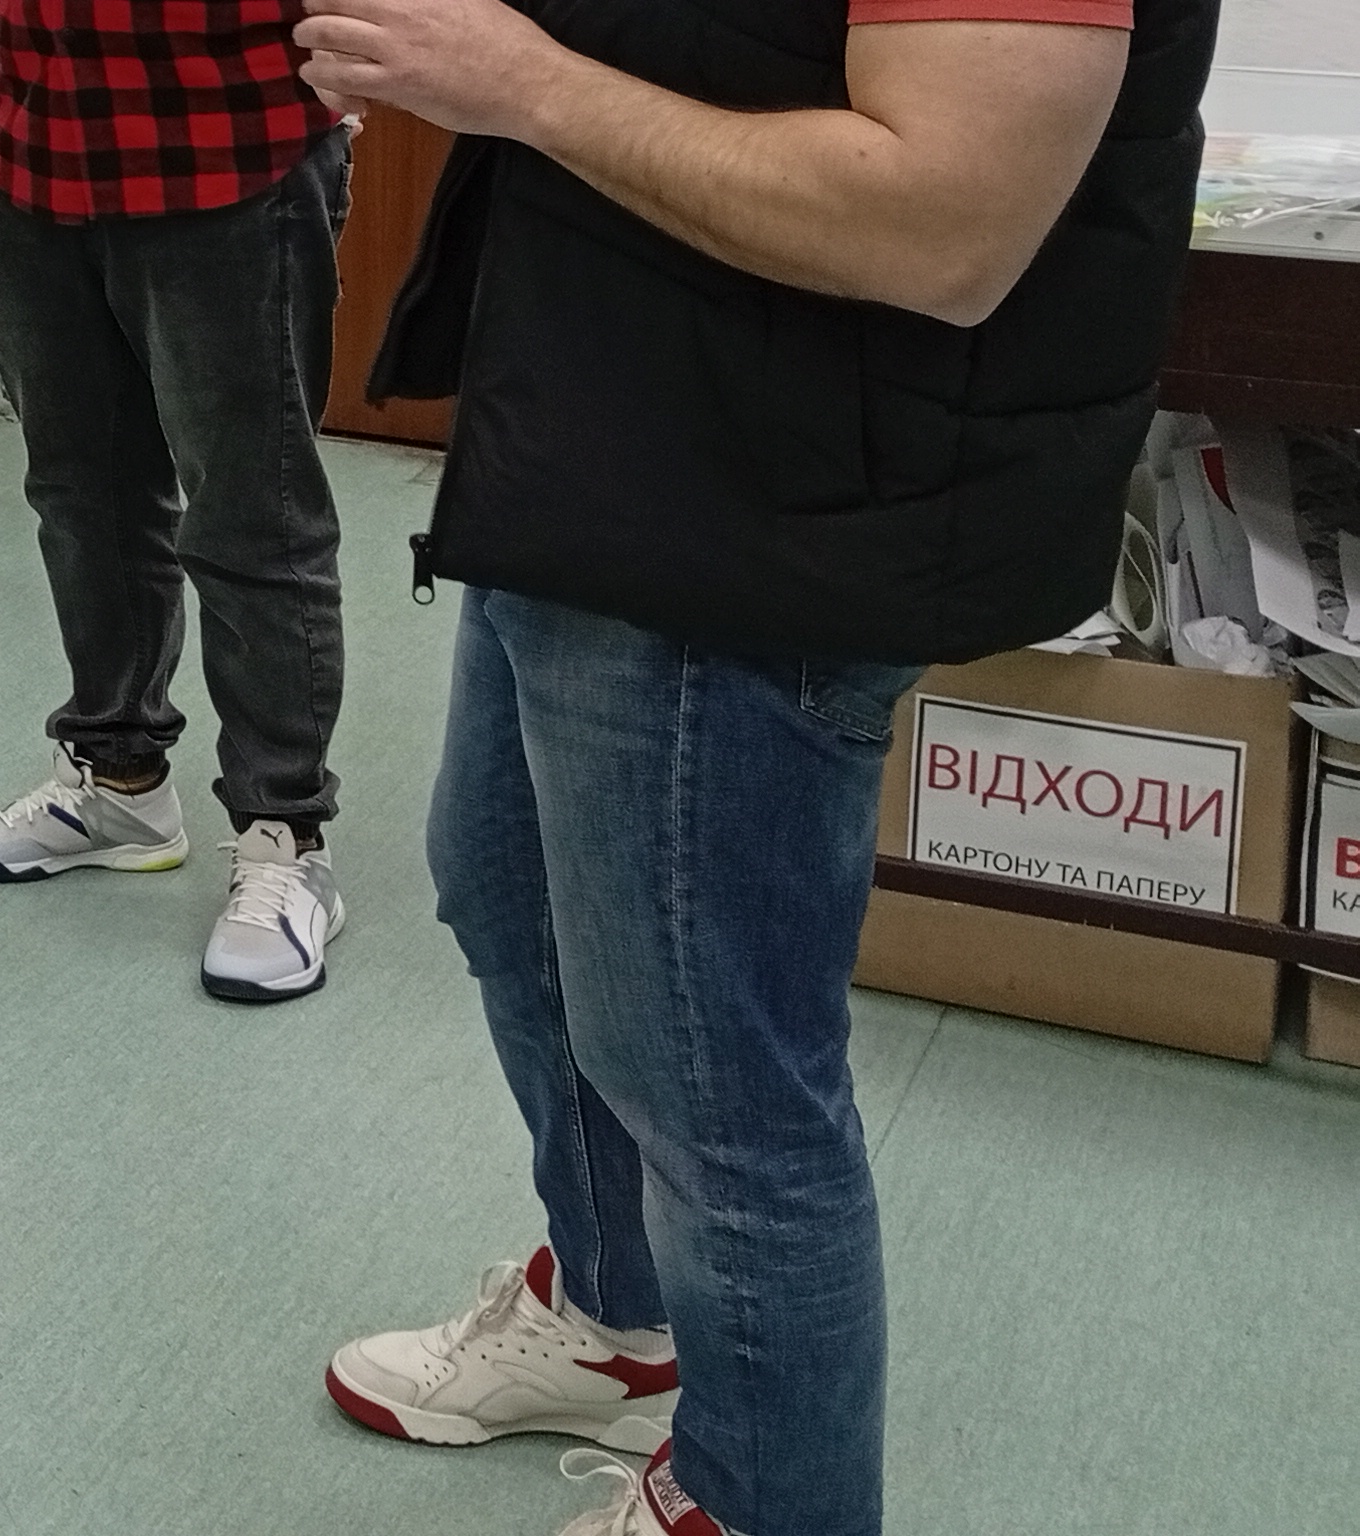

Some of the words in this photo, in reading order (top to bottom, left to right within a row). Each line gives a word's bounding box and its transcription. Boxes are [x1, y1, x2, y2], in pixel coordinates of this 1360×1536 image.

[926, 743, 1225, 840] ВІДХОДИ
[928, 840, 1050, 879] КАРТОНУ
[1056, 862, 1087, 887] ТА
[1096, 870, 1206, 906] ПАПЕРУ
